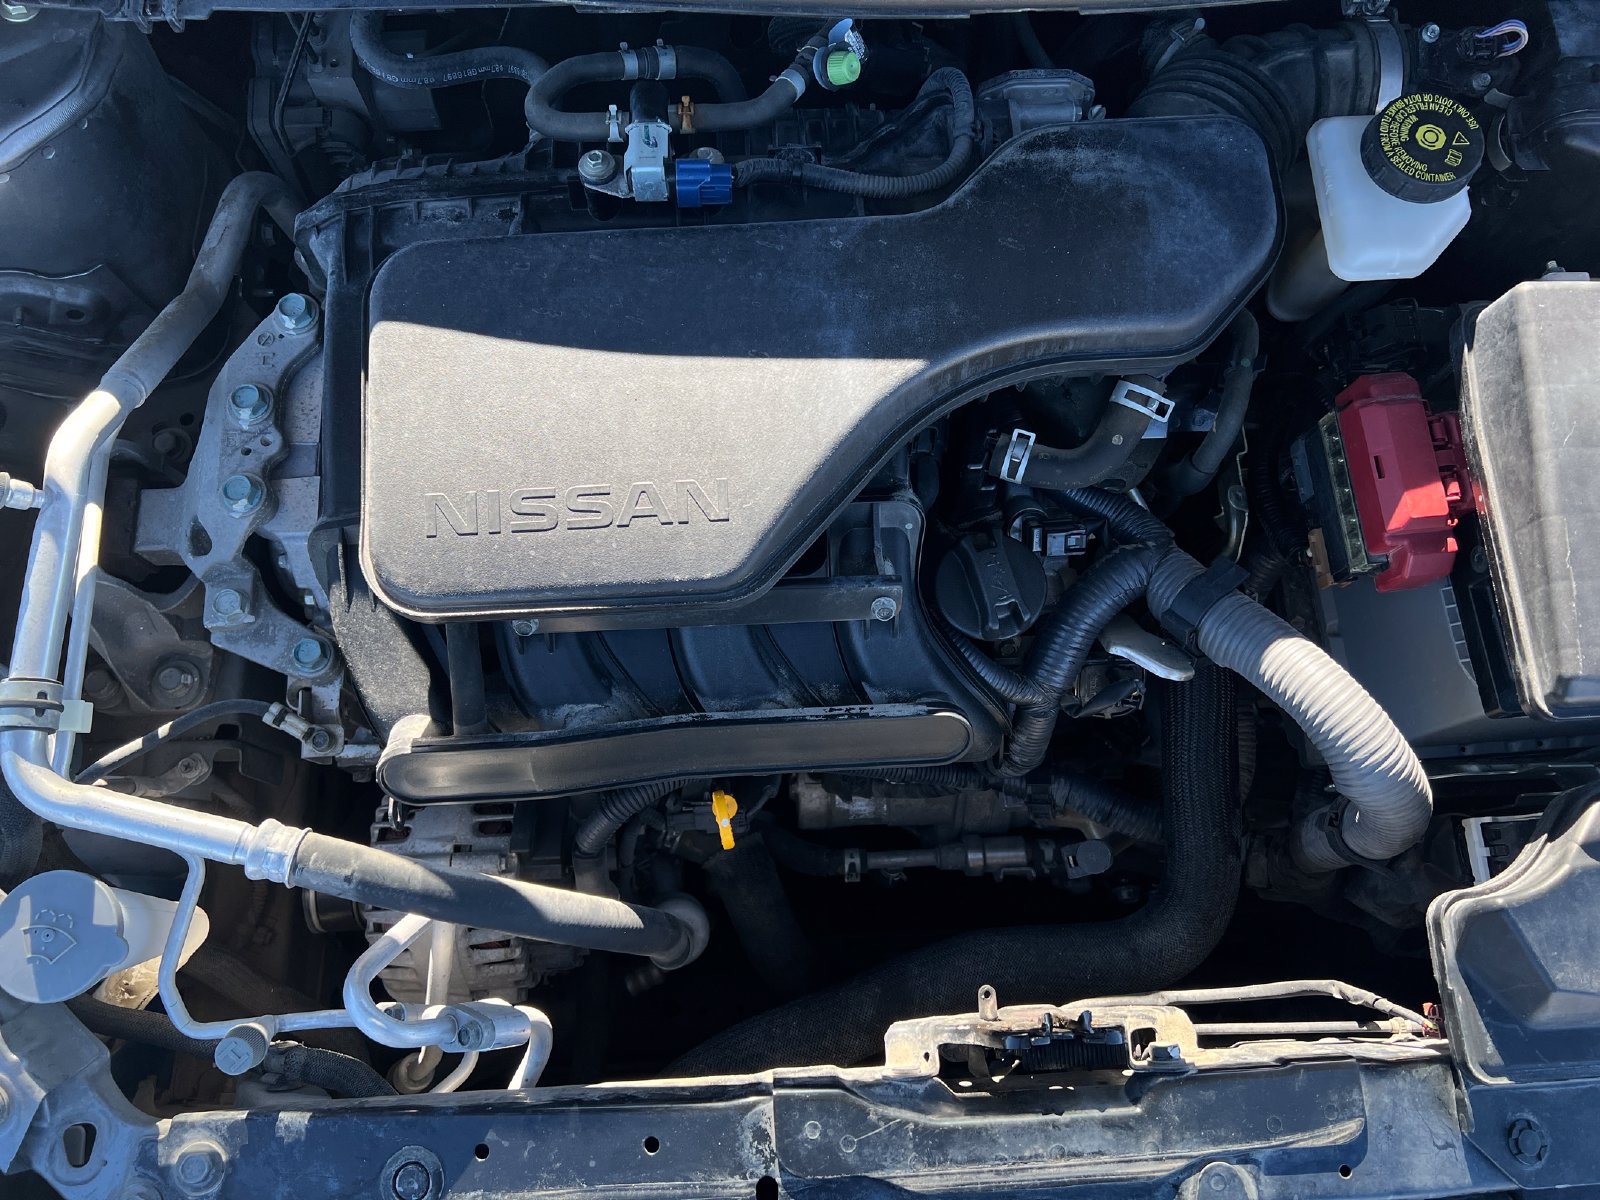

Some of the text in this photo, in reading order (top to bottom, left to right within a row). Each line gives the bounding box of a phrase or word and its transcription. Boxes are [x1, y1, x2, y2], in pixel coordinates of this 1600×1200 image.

[1404, 94, 1422, 105] DOT4
[1423, 93, 1433, 102] OR
[1434, 94, 1453, 106] DOT3
[1385, 99, 1406, 117] BRAKE
[1452, 102, 1470, 118] ONLY
[1380, 116, 1391, 133] FLUID
[1400, 114, 1419, 142] WARNING
[1467, 117, 1479, 130] USE
[1380, 133, 1392, 152] FROM
[1390, 102, 1453, 172] CLEAN FILLER CAP BEFORE REMOVING
[1390, 155, 1415, 176] SEALED
[1415, 171, 1456, 182] CONTAINER
[425, 477, 730, 538] NISSAN
